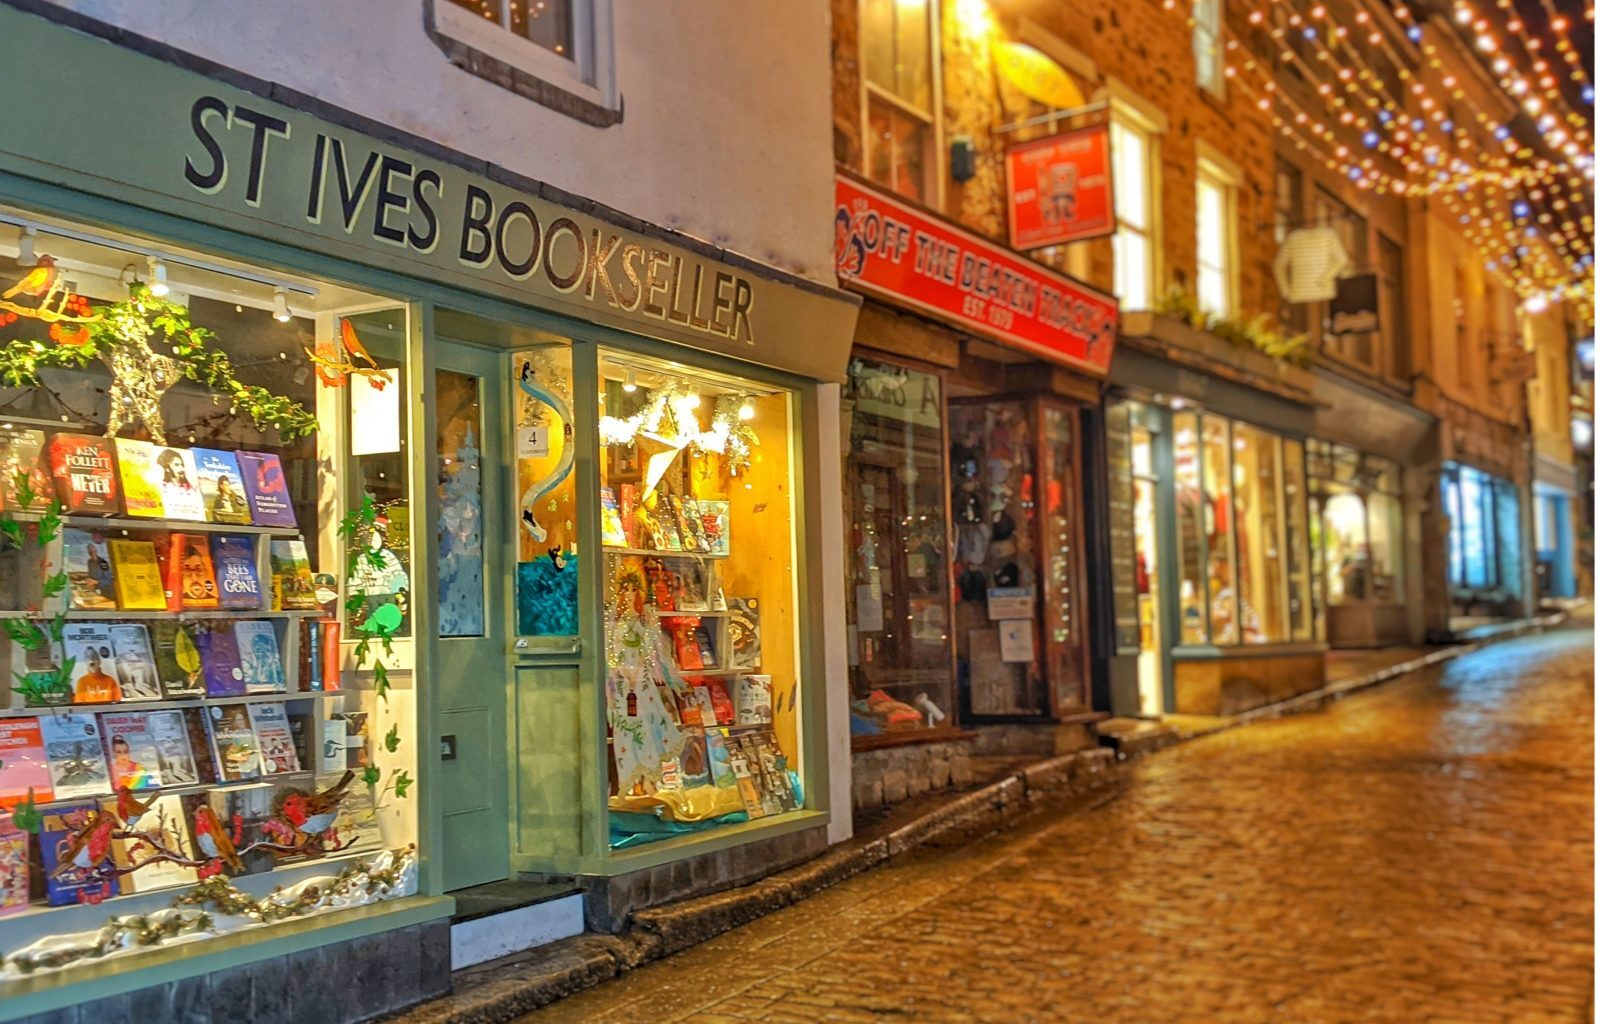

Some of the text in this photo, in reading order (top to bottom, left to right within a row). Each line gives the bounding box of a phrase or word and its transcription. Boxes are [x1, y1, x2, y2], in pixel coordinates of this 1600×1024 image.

[185, 96, 755, 346] ST IVES BOOKSELLER
[863, 208, 911, 264] OFF
[914, 230, 960, 286] THE
[959, 250, 1039, 318] BEATEN
[1038, 284, 1100, 342] TRACK
[528, 431, 537, 446] 4
[76, 446, 99, 457] KEN
[65, 454, 111, 470] FOLLETT
[71, 472, 111, 494] NEVER
[223, 579, 258, 593] GONE
